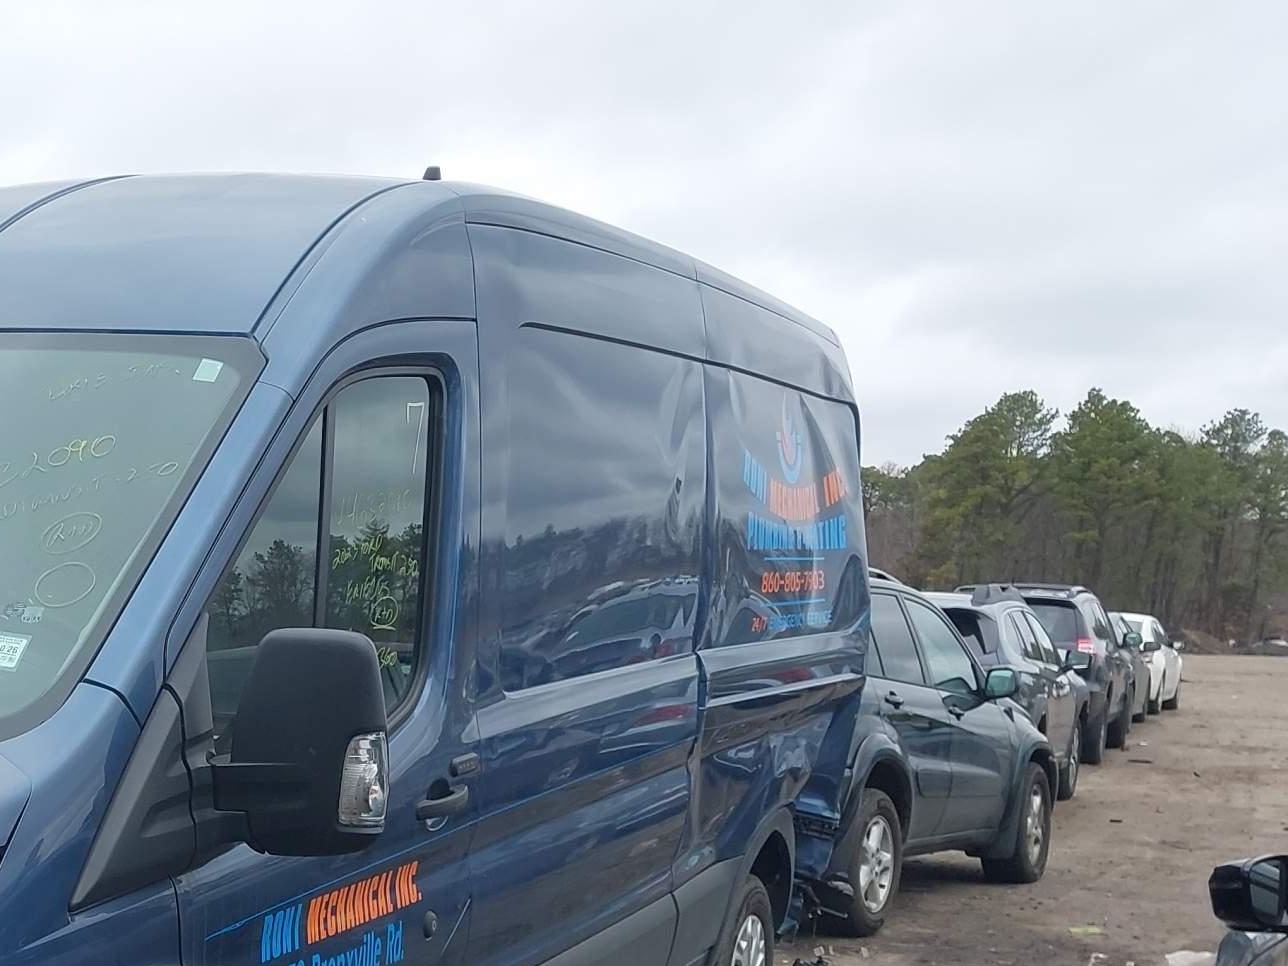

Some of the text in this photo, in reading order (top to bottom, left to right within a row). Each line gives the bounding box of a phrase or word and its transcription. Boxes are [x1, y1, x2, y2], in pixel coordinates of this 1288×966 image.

[307, 870, 394, 945] MECHANICAL
[395, 860, 423, 909] INC.
[385, 921, 405, 966] Rd.
